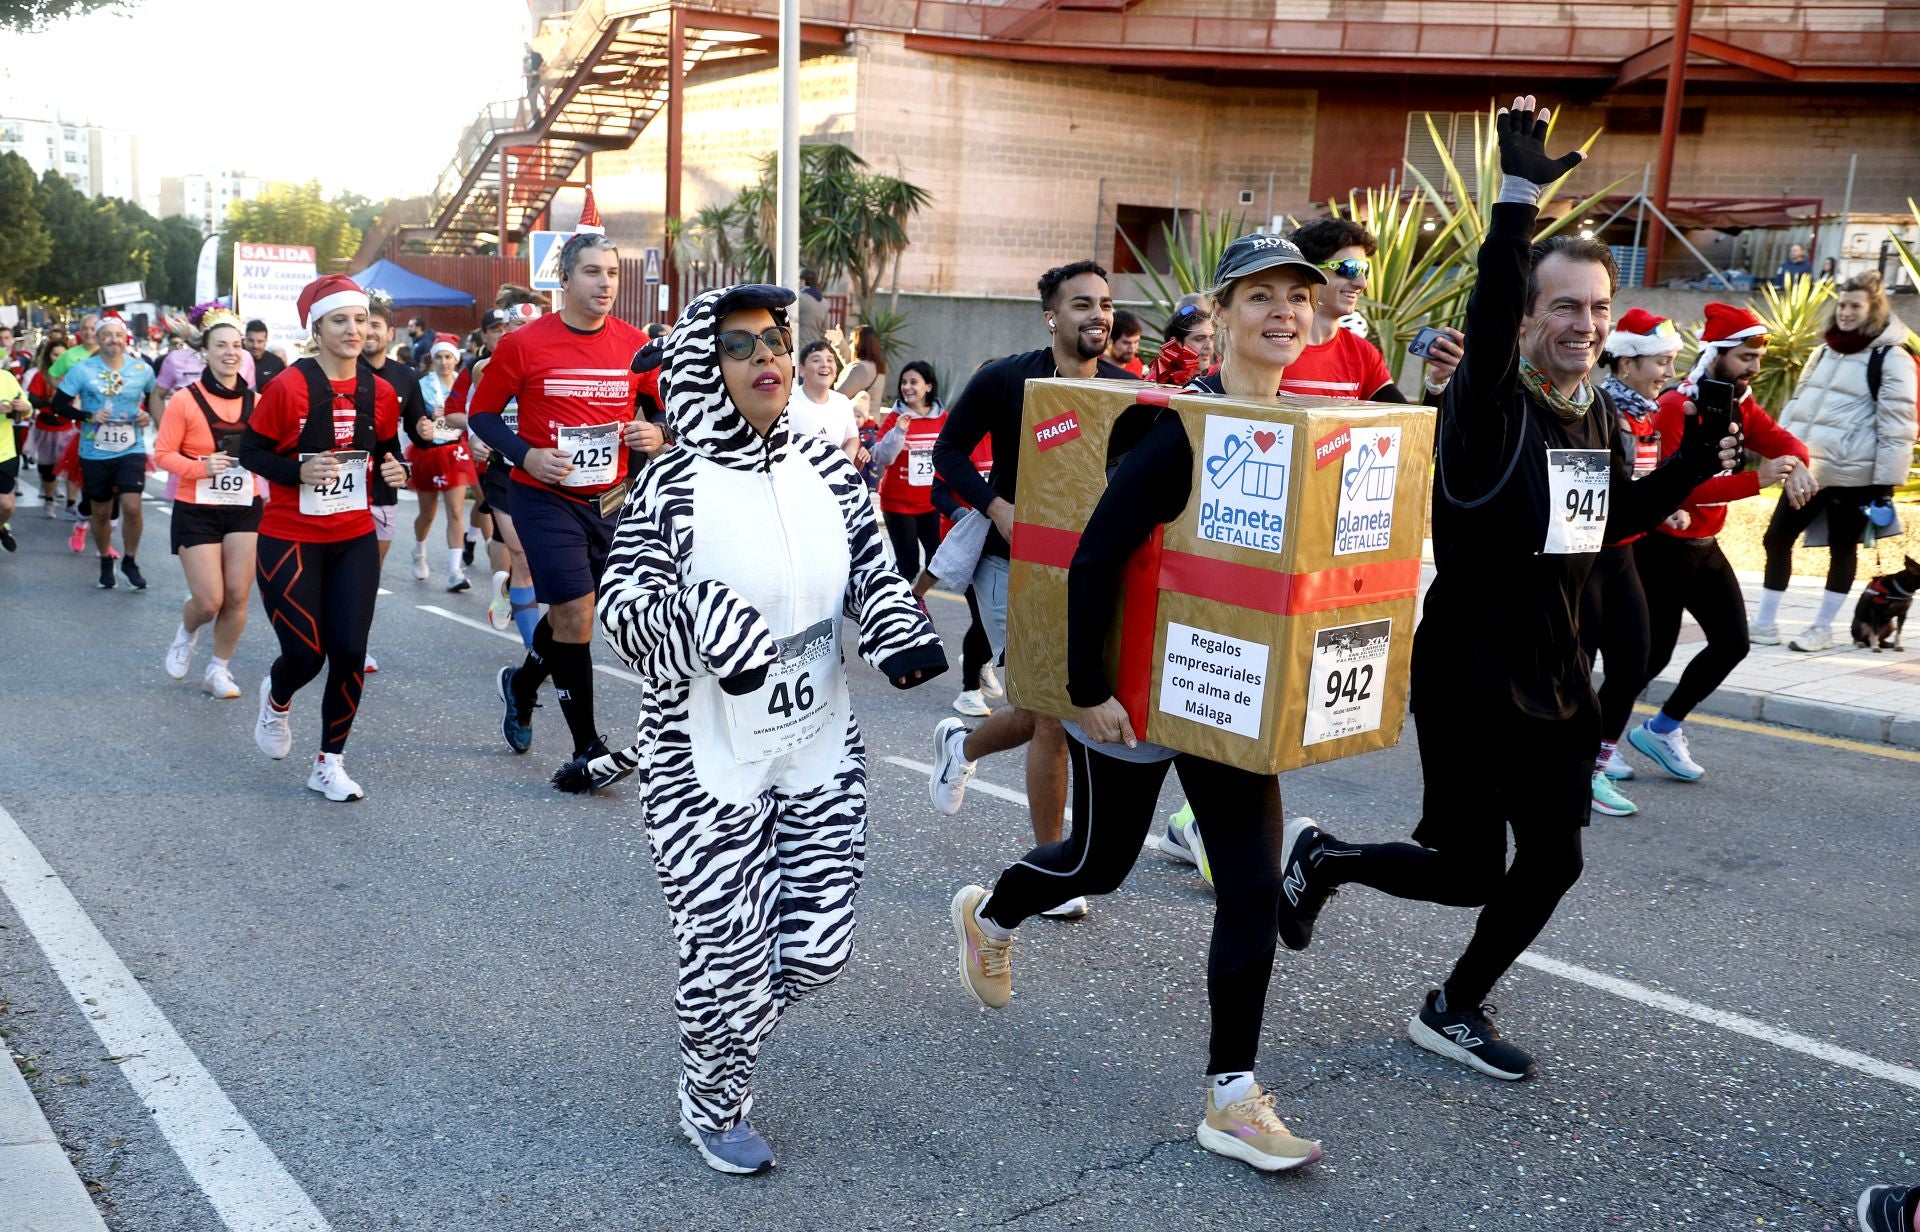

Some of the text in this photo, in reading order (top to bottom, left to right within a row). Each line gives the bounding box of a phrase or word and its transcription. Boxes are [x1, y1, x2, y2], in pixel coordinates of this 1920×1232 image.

[241, 246, 312, 262] SALIDA
[243, 265, 313, 280] XIV CARRERA
[103, 432, 128, 443] 116
[1036, 418, 1078, 442] FRAGIL
[572, 446, 612, 468] 425
[1316, 432, 1351, 460] FRAGIL
[209, 475, 243, 491] 169
[1201, 499, 1283, 532] planeta
[1565, 488, 1607, 522] 941
[1337, 510, 1391, 541] planeta
[1191, 633, 1241, 657] Regalos
[1367, 635, 1389, 646] XIV
[1168, 652, 1262, 686] empresariales
[767, 671, 815, 718] 46
[1172, 676, 1251, 706] con alma de
[1325, 664, 1374, 708] 942
[1185, 699, 1232, 725] Málaga
